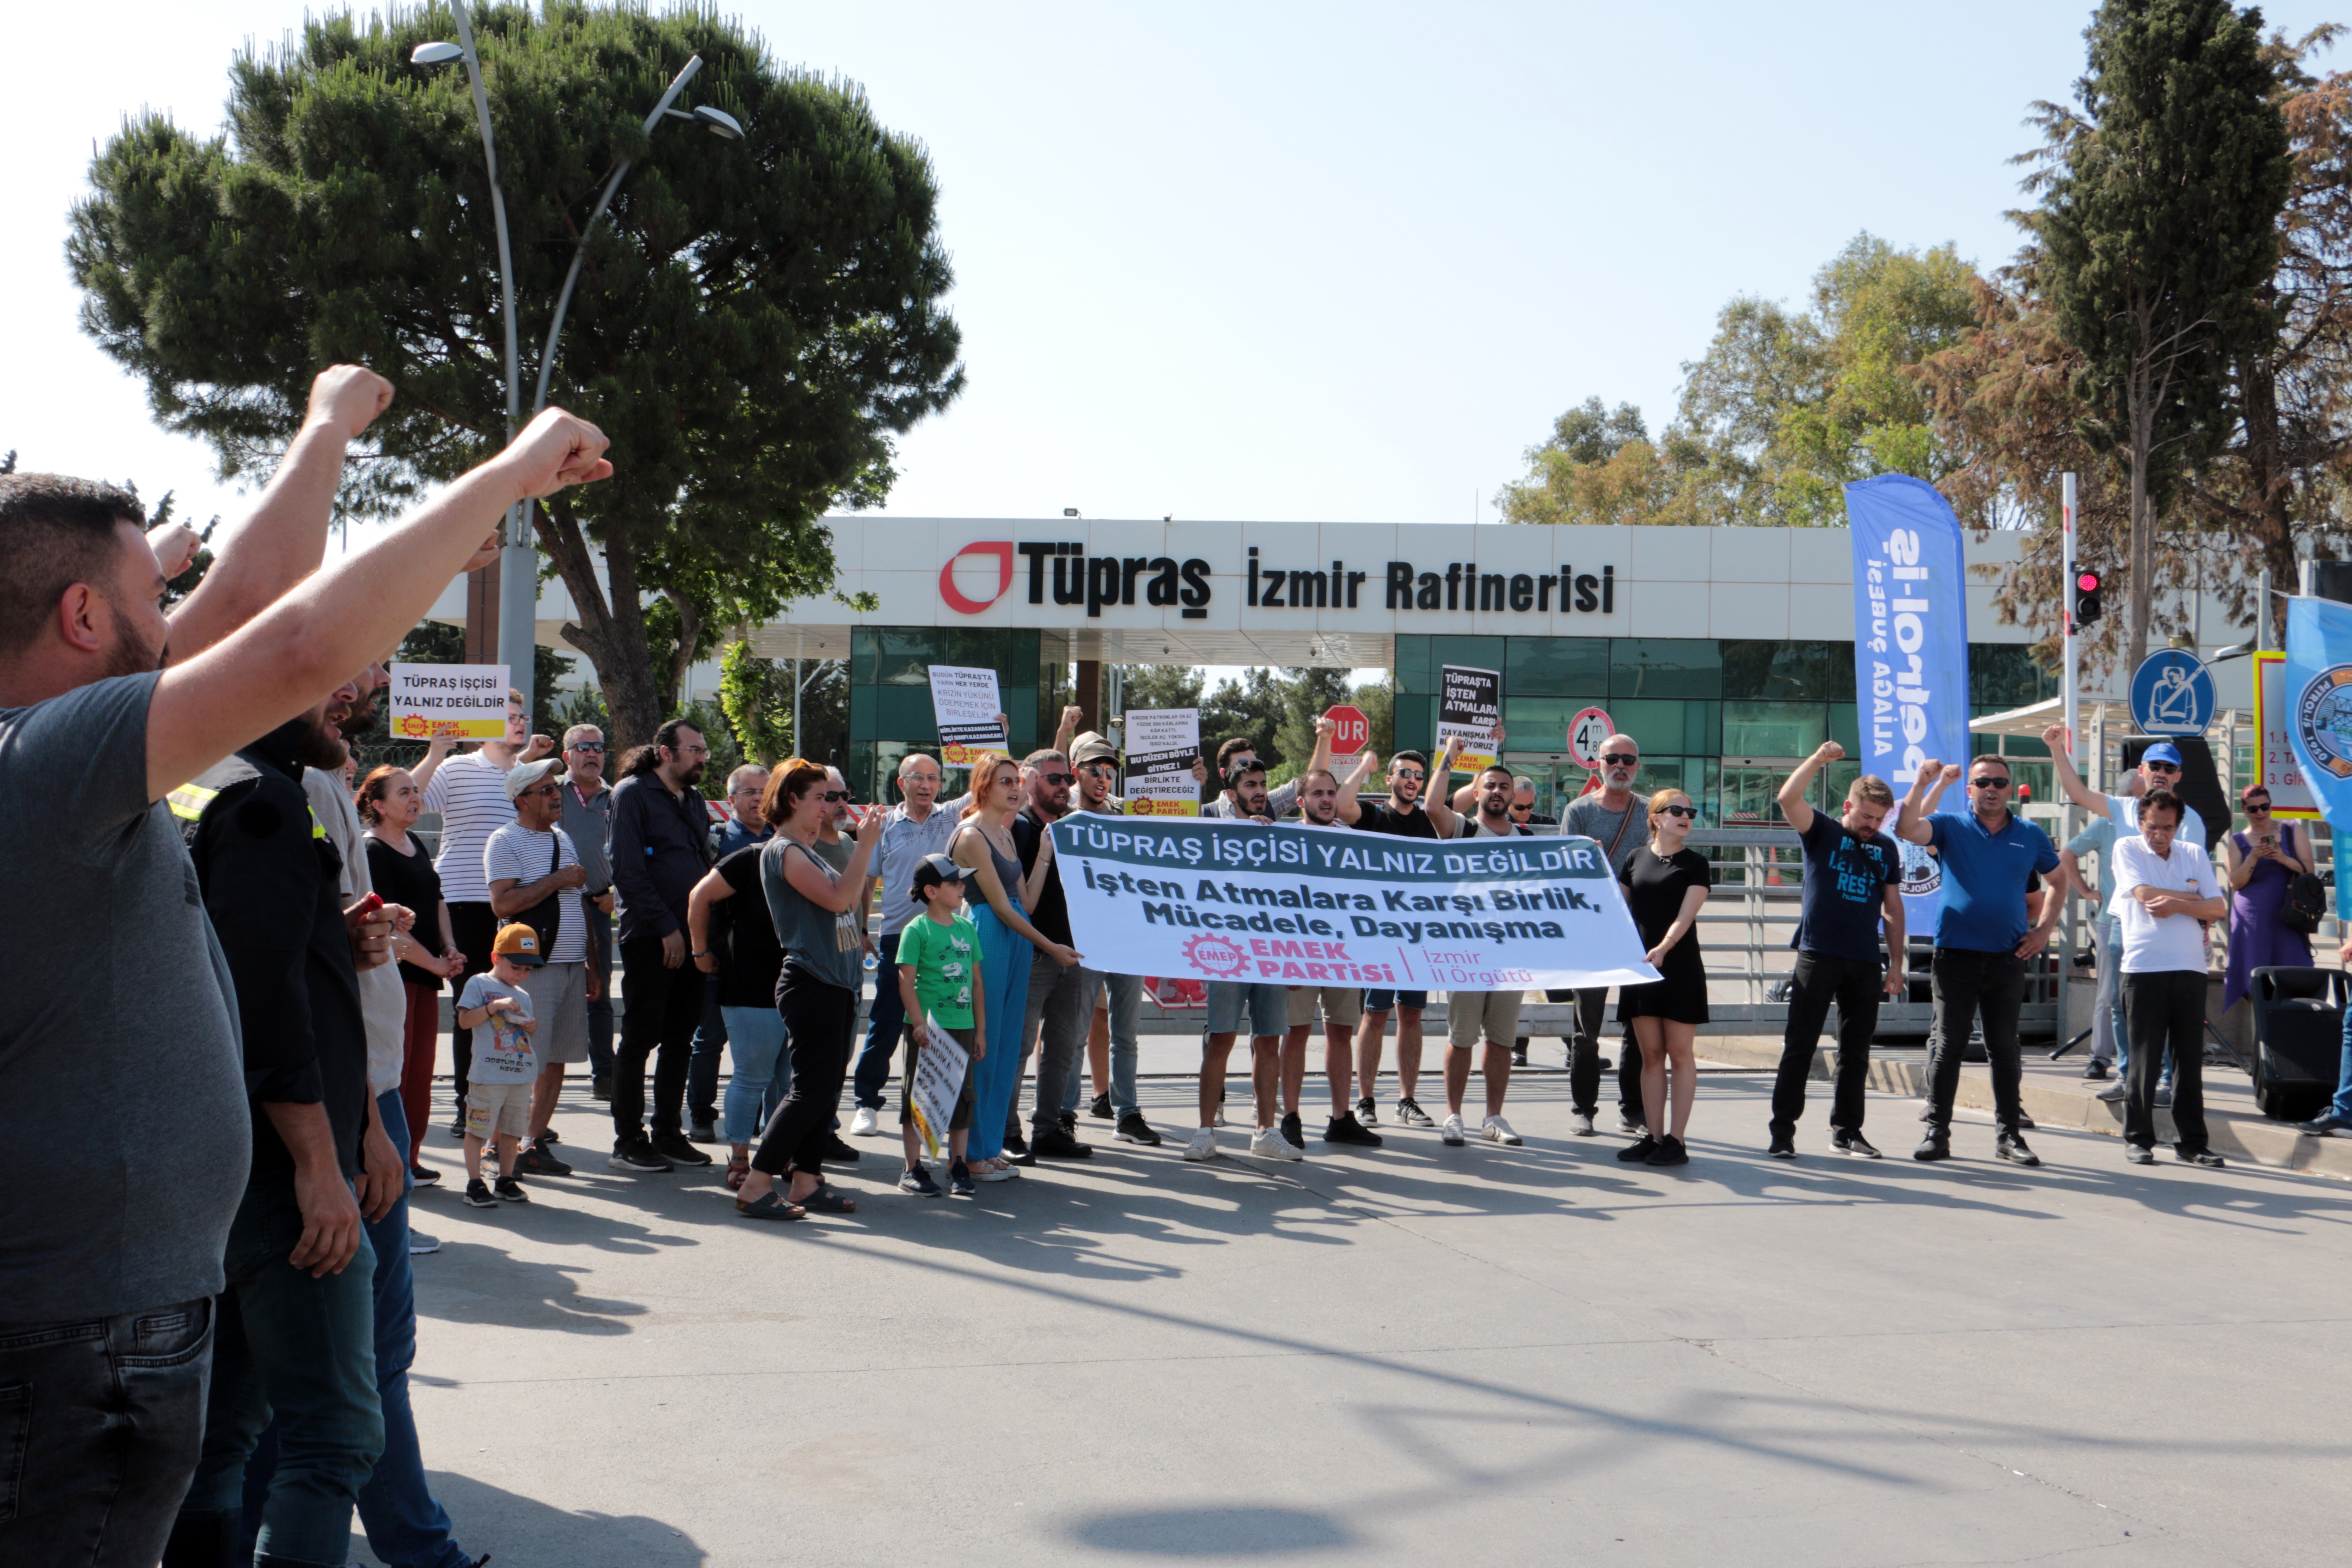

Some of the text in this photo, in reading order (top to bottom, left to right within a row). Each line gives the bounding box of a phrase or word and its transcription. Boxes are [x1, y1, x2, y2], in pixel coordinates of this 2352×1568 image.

[1019, 541, 1614, 619] Tüpraş İzmir Rafinerisi
[403, 674, 496, 691] TÜPRAŞ İŞÇİSİ
[955, 671, 992, 681] TÜPRAŞ'TA
[1446, 672, 1491, 688] TÜPRAŞ'TA
[938, 689, 994, 700] KRİZİN YÜKÜNÜ
[1446, 685, 1476, 700] İŞTEN
[395, 695, 504, 707] YALNIZ DEĞİLDİR
[939, 698, 995, 711] ÖDEMEMEK İÇİN
[1445, 701, 1497, 715] ATMALARA
[946, 708, 989, 719] BİRLEŞELİM
[1472, 716, 1496, 727] KARŞI
[1338, 720, 1364, 741] UR
[1576, 725, 1589, 751] 4
[1142, 753, 1169, 763] DÜZEN
[1169, 748, 1195, 758] BÖYLE
[2306, 736, 2328, 761] 1950
[2269, 751, 2279, 763] 2.
[1148, 762, 1176, 773] GİTMEZ
[2269, 772, 2279, 785] 3.
[1130, 786, 1194, 796] DEĞİŞTİRECEĞİZ
[1065, 824, 1595, 874] TÜPRAŞ İŞÇİSİ YALNIZ DEĞİLDİR
[1082, 860, 1601, 916] İşten Atmalara Karşı Birlik,
[1142, 901, 1565, 944] Mücadele, Dayanışma
[1197, 949, 1237, 962] EMEP
[1249, 938, 1353, 960] EMEK
[1421, 946, 1481, 964] İzmir
[1430, 965, 1534, 986] İl Örgütü
